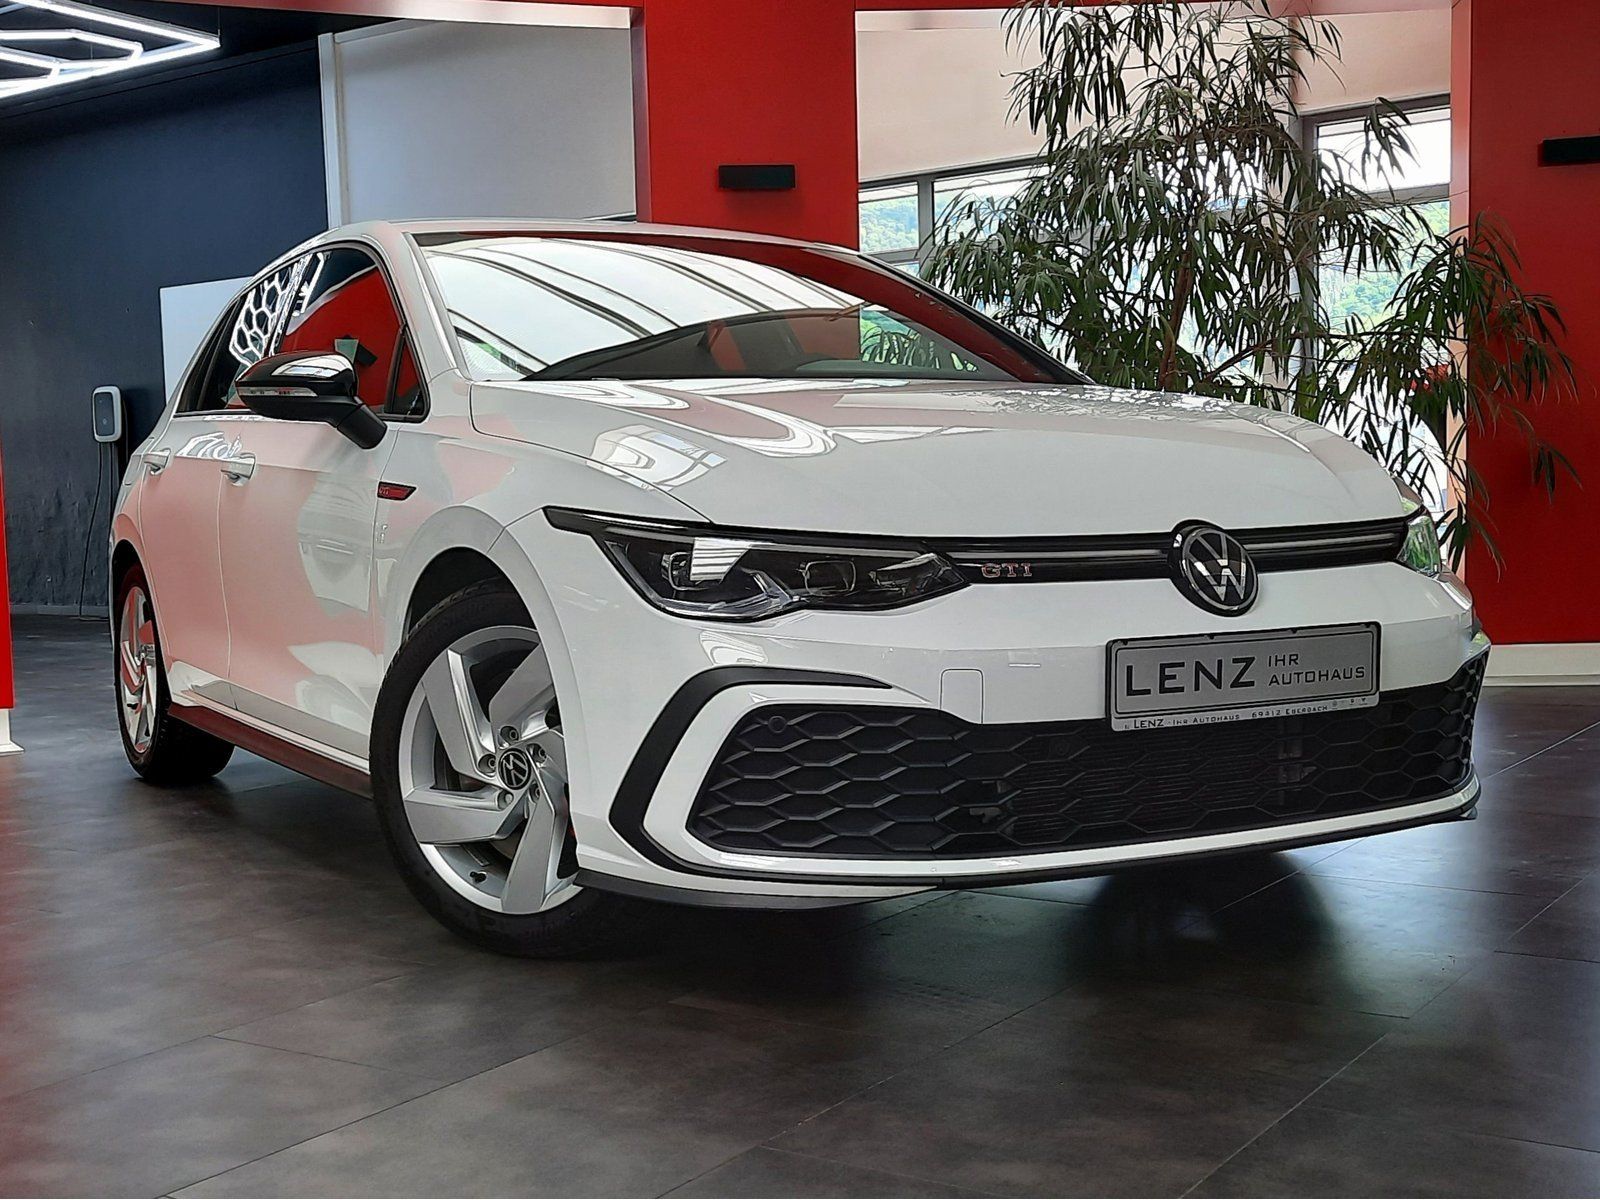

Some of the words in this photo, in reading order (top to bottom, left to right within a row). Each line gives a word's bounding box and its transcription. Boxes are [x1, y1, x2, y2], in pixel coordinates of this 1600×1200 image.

[981, 563, 1033, 578] GTI
[1268, 654, 1299, 668] IHR
[1126, 656, 1256, 697] LENZ
[1268, 666, 1366, 687] AUTOHAUS
[1133, 718, 1165, 729] LENZ
